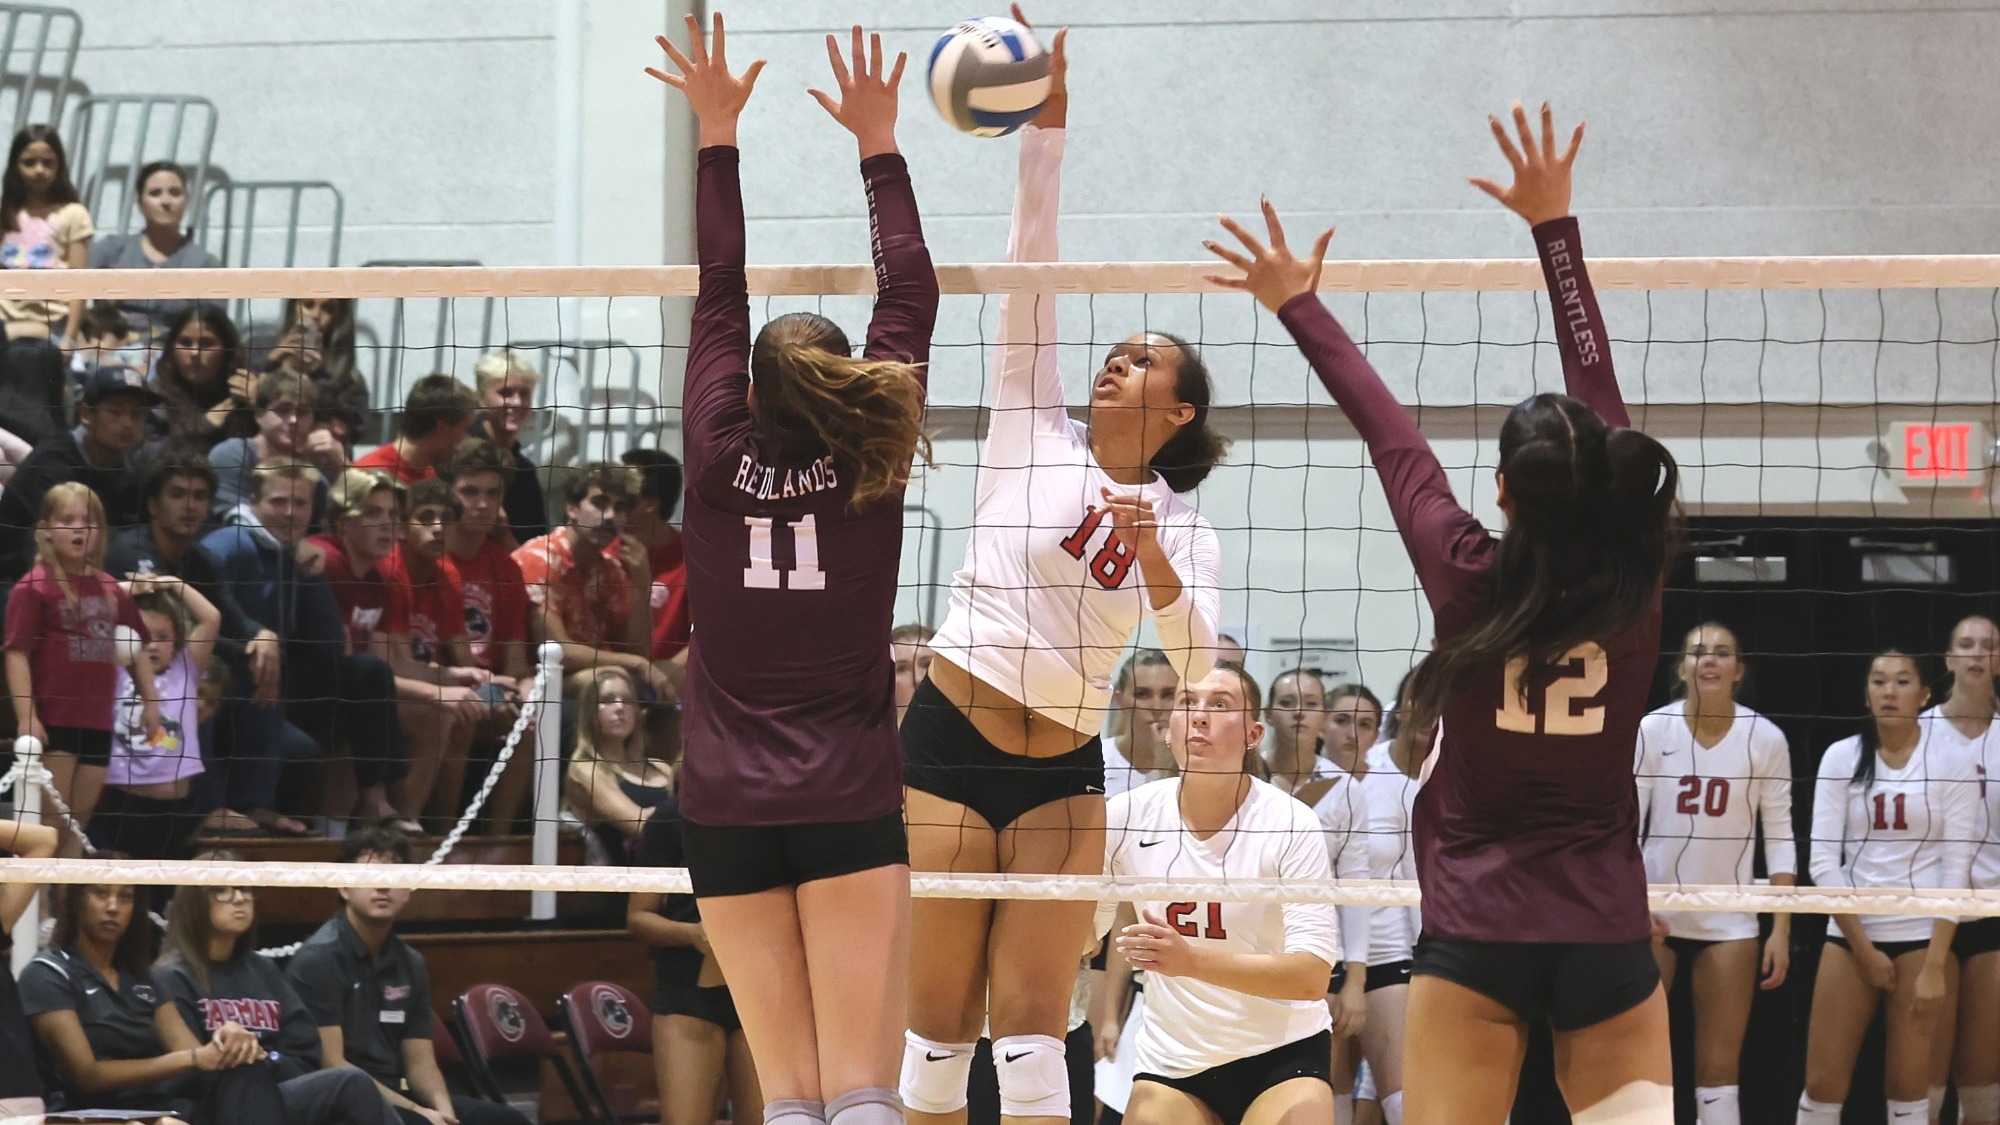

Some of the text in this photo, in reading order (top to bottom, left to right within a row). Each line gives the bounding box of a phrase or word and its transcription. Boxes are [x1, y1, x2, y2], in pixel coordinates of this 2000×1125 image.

[1547, 237, 1600, 367] RELENTLESS
[732, 454, 838, 500] REDLANDS
[1904, 424, 1972, 479] EXIT
[743, 513, 826, 590] 11
[1059, 504, 1136, 590] 18
[1496, 640, 1608, 736] 12
[1676, 774, 1730, 817] 20
[1873, 793, 1908, 831] 11
[1166, 901, 1227, 940] 21
